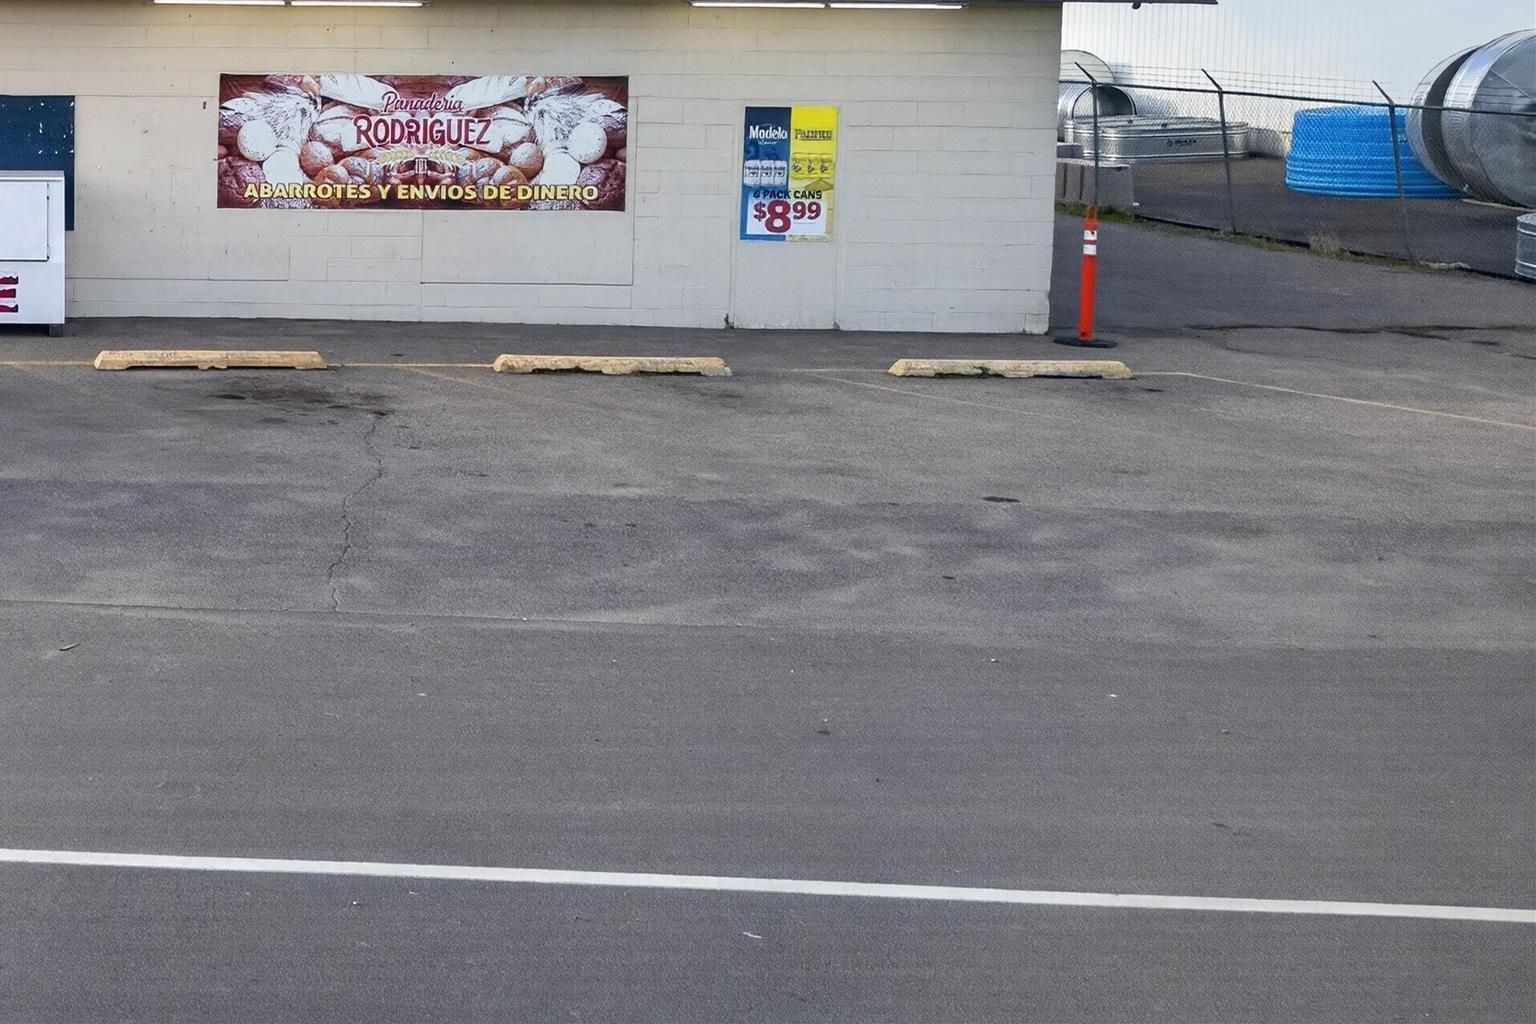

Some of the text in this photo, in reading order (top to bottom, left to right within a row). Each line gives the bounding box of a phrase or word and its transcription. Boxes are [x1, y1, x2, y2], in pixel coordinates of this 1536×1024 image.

[353, 115, 493, 148] RODRIGUEZ
[749, 125, 788, 139] Modelo
[244, 183, 599, 201] ABARROTES Y ENVIOS DE DINERO
[763, 190, 791, 199] PACK
[793, 190, 822, 199] CANS
